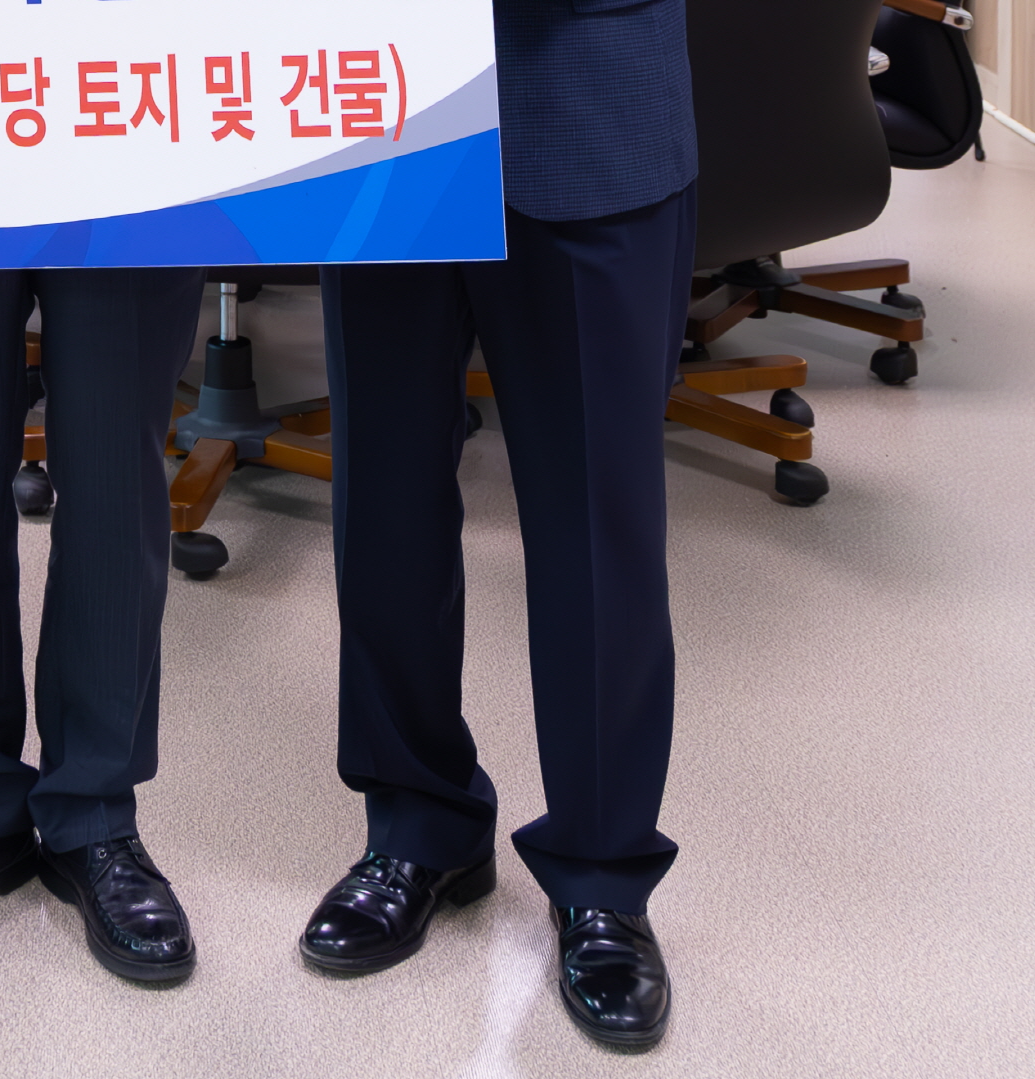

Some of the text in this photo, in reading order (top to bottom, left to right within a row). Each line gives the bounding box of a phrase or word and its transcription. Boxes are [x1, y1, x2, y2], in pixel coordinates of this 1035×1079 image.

[74, 54, 180, 142] 토지
[204, 51, 255, 141] 및
[280, 44, 407, 141] 건물)
